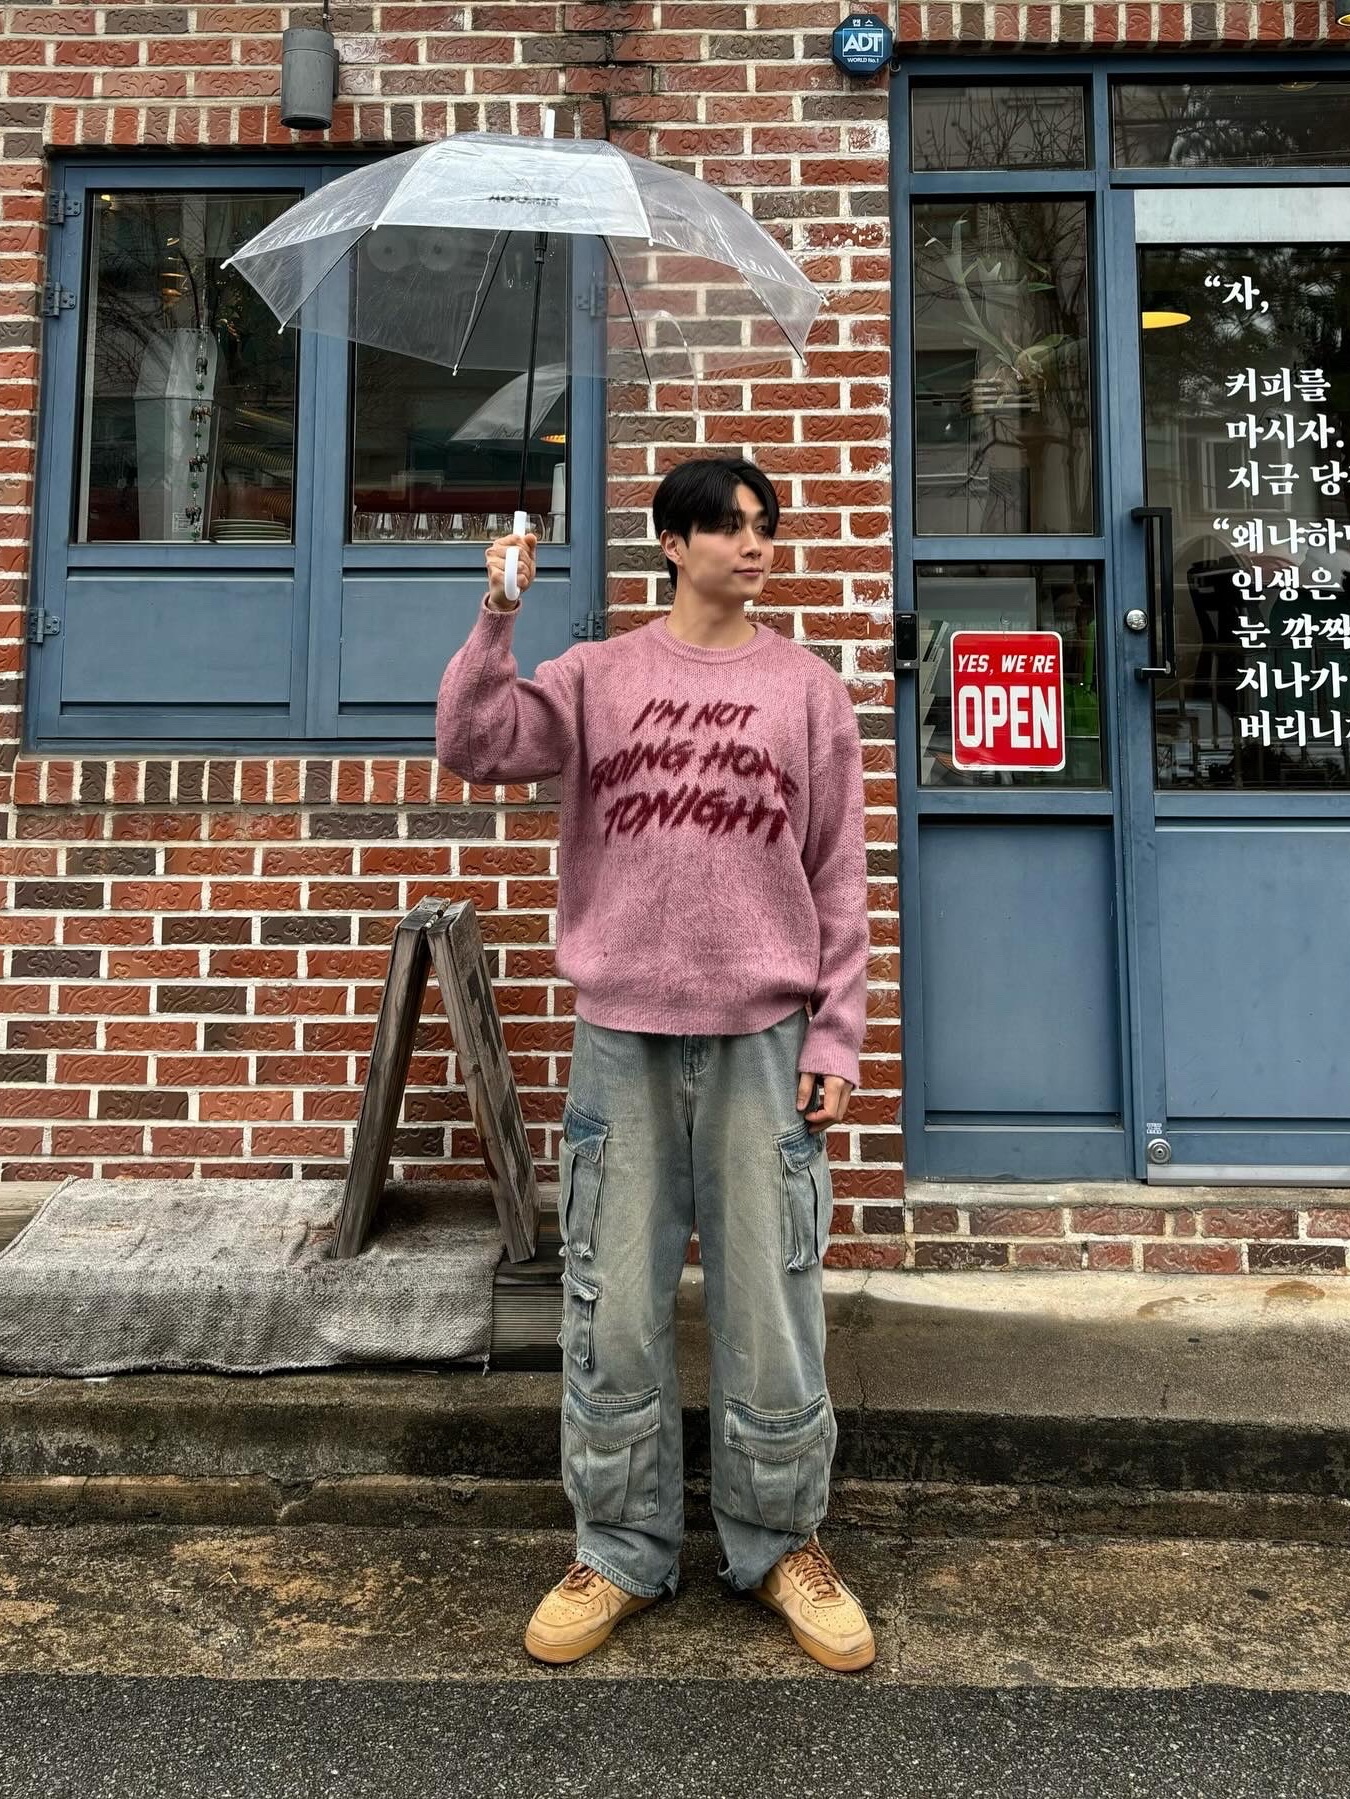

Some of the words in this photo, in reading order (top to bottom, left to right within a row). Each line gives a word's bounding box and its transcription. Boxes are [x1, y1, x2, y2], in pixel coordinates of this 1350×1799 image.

[843, 33, 883, 52] ADT
[1225, 367, 1331, 403] 커피를
[1225, 413, 1345, 449] 마시자.
[1227, 460, 1300, 497] 지금
[1309, 460, 1350, 497] 당
[1232, 565, 1341, 602] 인생은
[1231, 615, 1271, 650] 눈
[957, 654, 995, 676] YES,
[1001, 654, 1057, 673] WE'RE
[1235, 661, 1348, 698] 지나가
[631, 698, 690, 733] I'M
[689, 699, 760, 731] NOT
[958, 684, 1058, 749] OPEN
[1238, 709, 1350, 747] 버리니
[590, 736, 696, 800] GOING
[604, 783, 789, 848] TONIGHT
